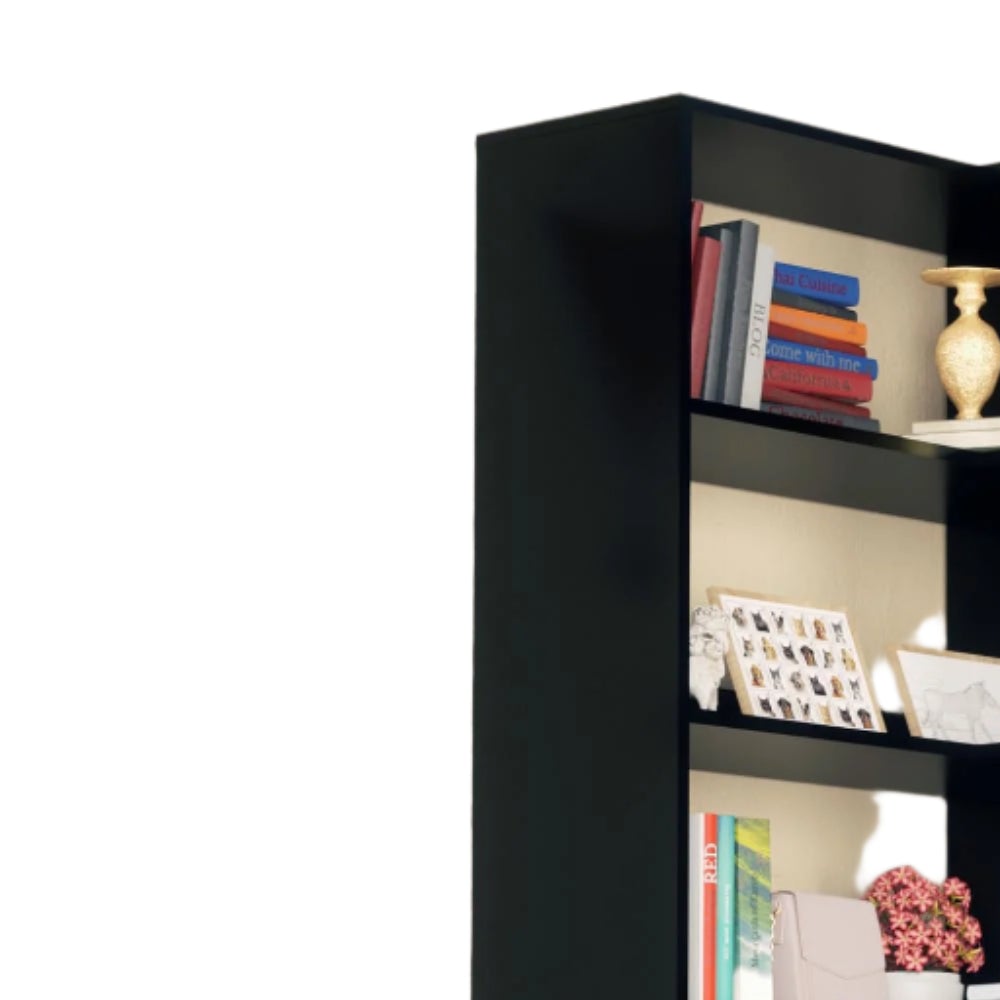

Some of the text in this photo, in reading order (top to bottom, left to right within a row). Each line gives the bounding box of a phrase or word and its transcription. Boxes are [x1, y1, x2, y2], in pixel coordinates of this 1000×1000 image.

[750, 302, 767, 358] BLOG
[806, 347, 835, 367] with
[839, 357, 861, 373] me
[704, 843, 717, 883] RED
